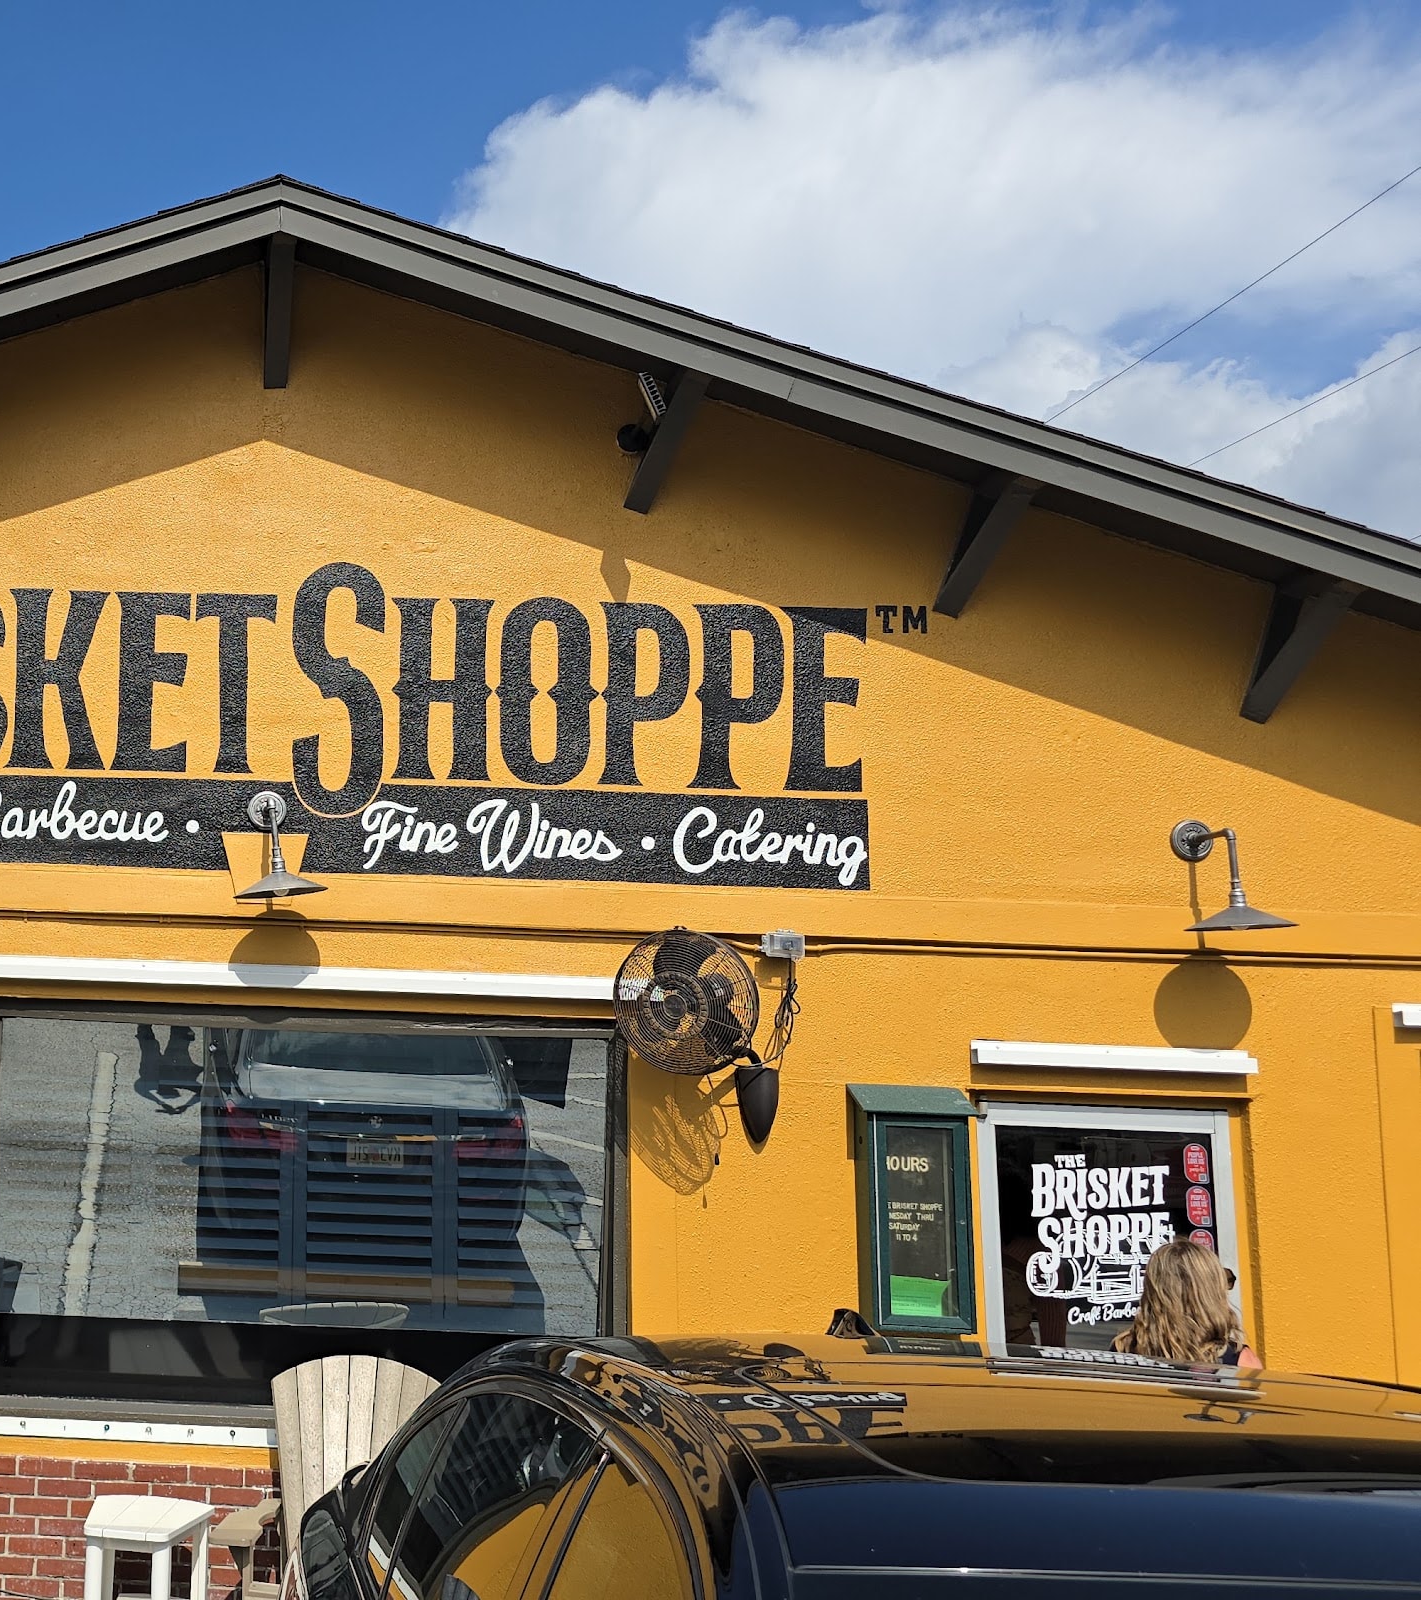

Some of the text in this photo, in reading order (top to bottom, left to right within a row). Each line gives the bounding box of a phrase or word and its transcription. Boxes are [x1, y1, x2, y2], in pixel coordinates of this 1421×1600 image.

[291, 561, 868, 814] SHOPPE
[361, 799, 459, 871] Fine
[467, 797, 622, 874] Wines
[672, 805, 869, 887] Catering
[1054, 1153, 1086, 1168] THE
[1031, 1163, 1170, 1221] BRISKET
[891, 1202, 918, 1210] BRISKET
[920, 1203, 943, 1211] SHOPPE
[888, 1212, 934, 1221] NESDAY THRU
[888, 1222, 920, 1231] SATURDAY
[912, 1234, 918, 1242] 4
[1067, 1302, 1141, 1326] Craft Barbe
